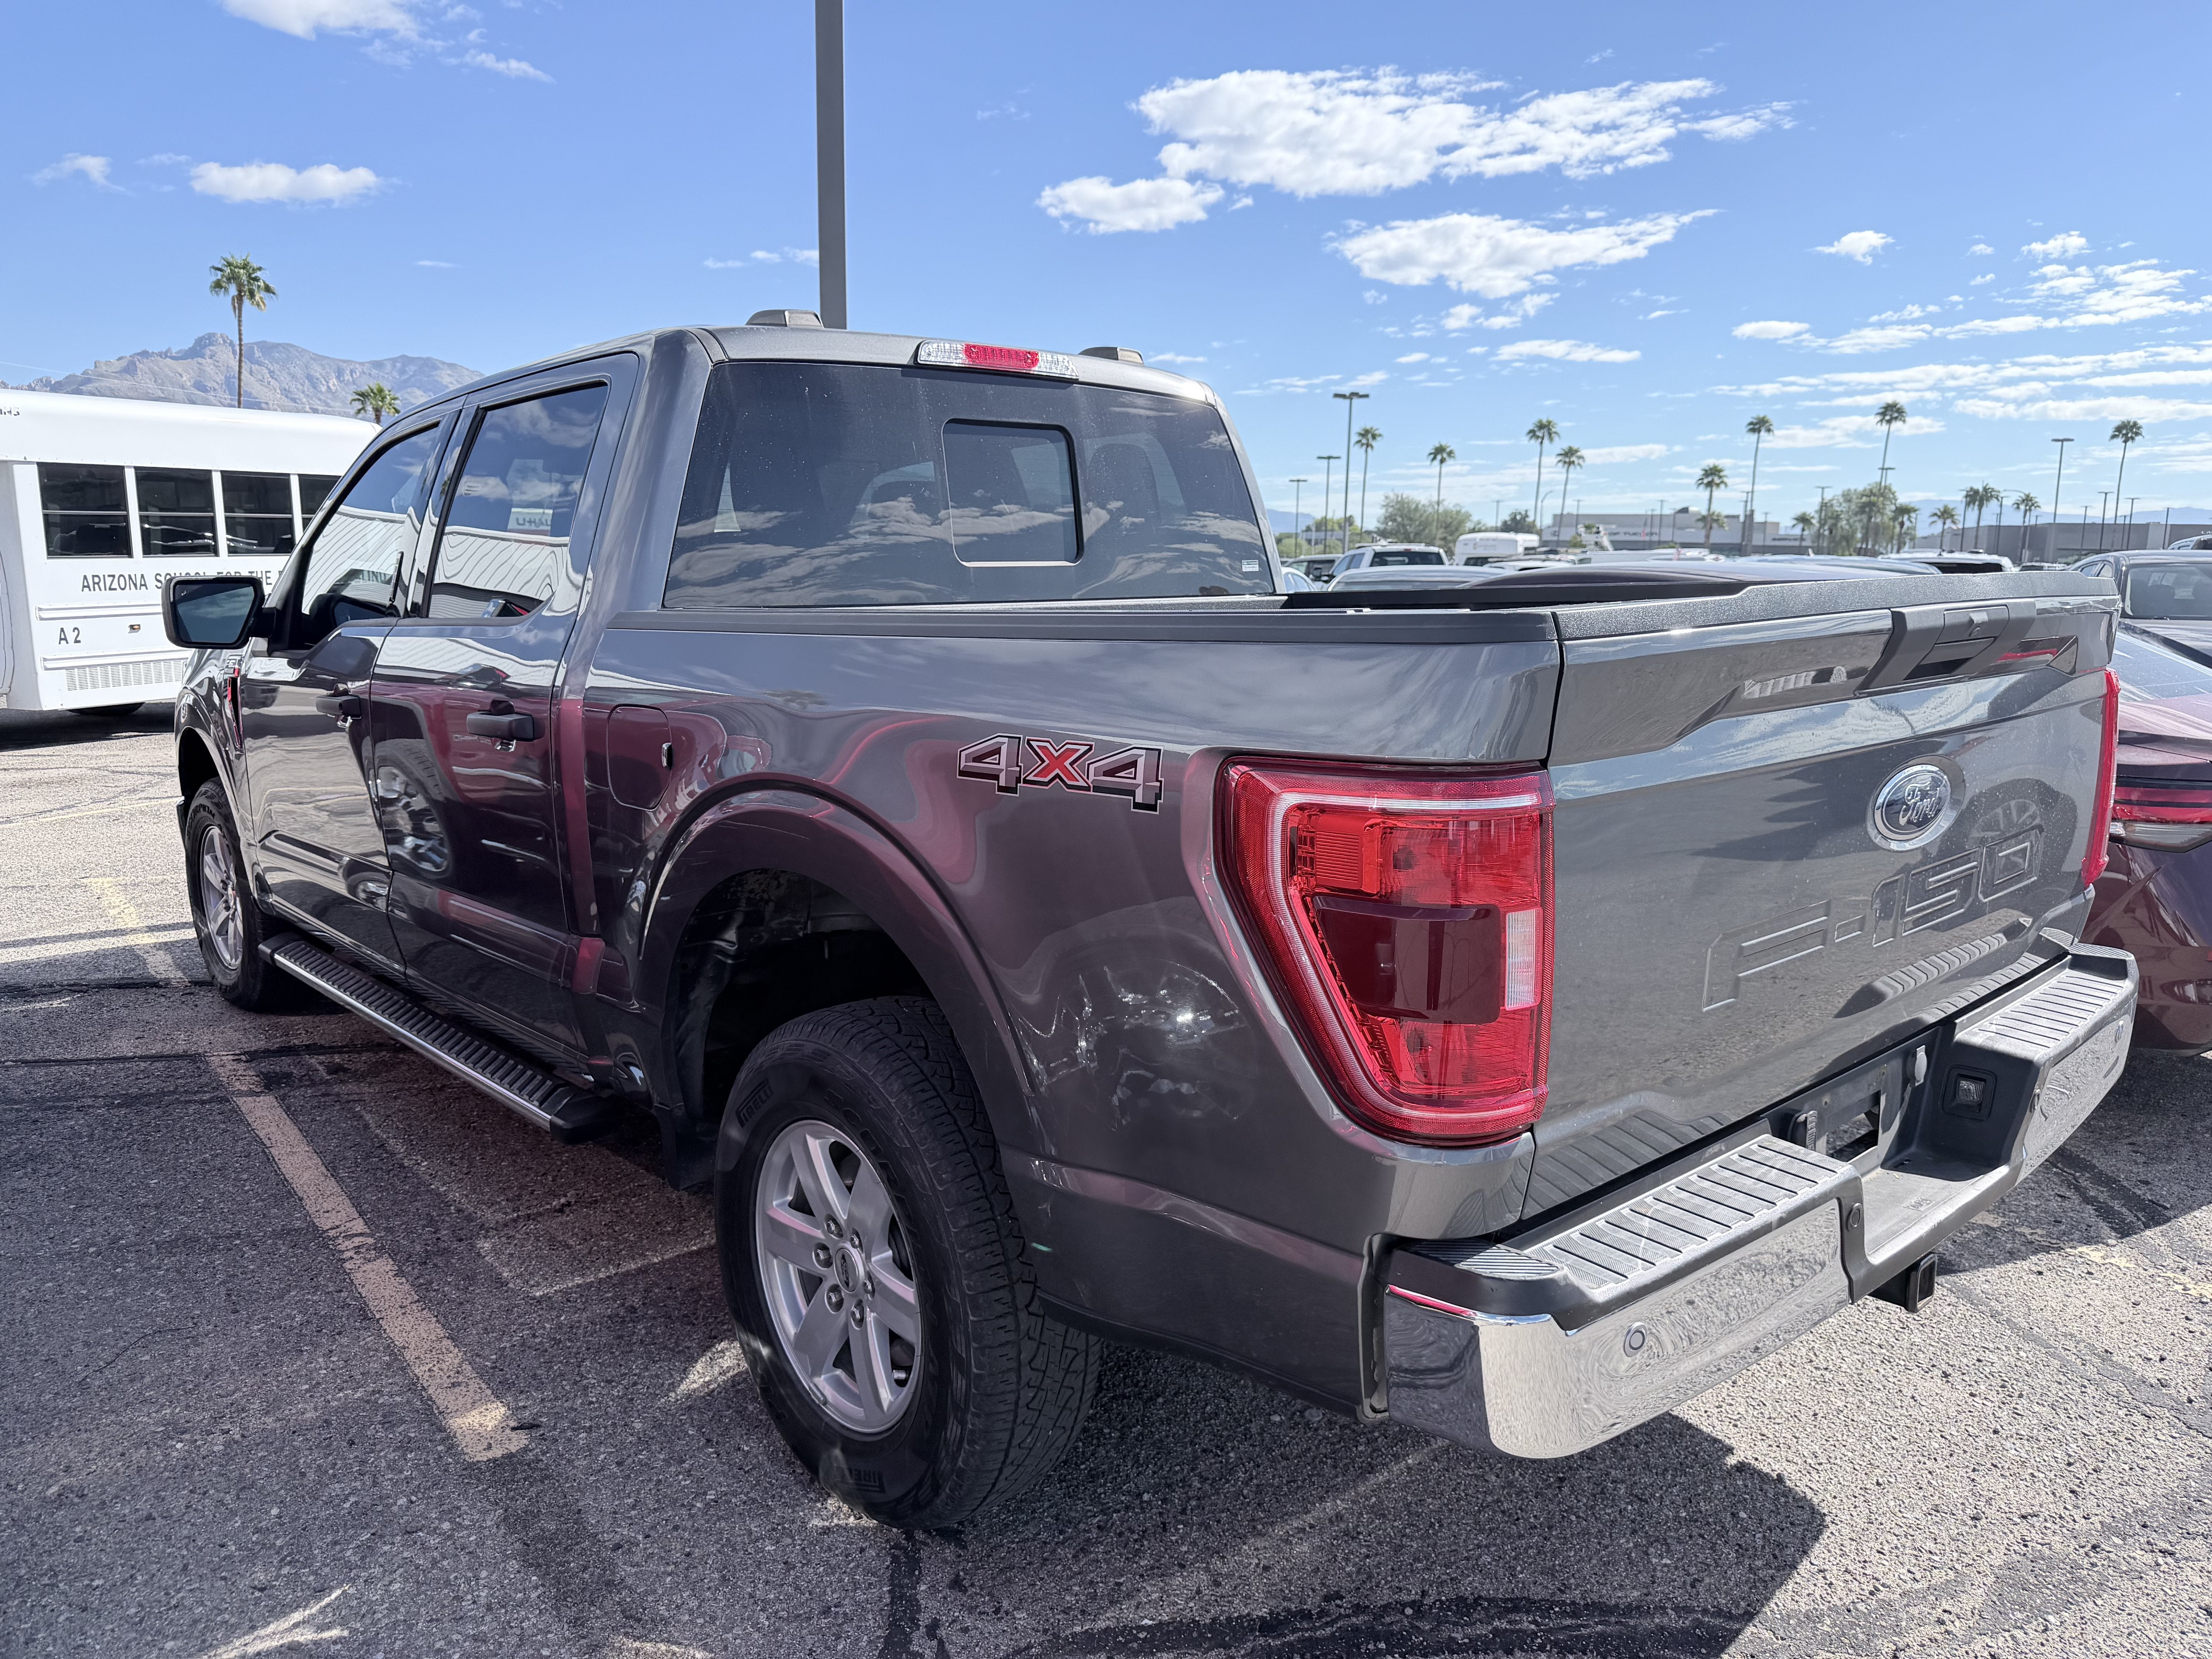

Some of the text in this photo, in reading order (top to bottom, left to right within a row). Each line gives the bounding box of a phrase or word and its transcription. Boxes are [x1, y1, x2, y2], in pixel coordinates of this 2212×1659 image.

[81, 574, 148, 592] ARIZONA
[58, 627, 81, 644] A 2
[1899, 781, 1940, 826] Ford
[1702, 827, 2044, 1012] F-150
[735, 1078, 774, 1128] PIRELLI
